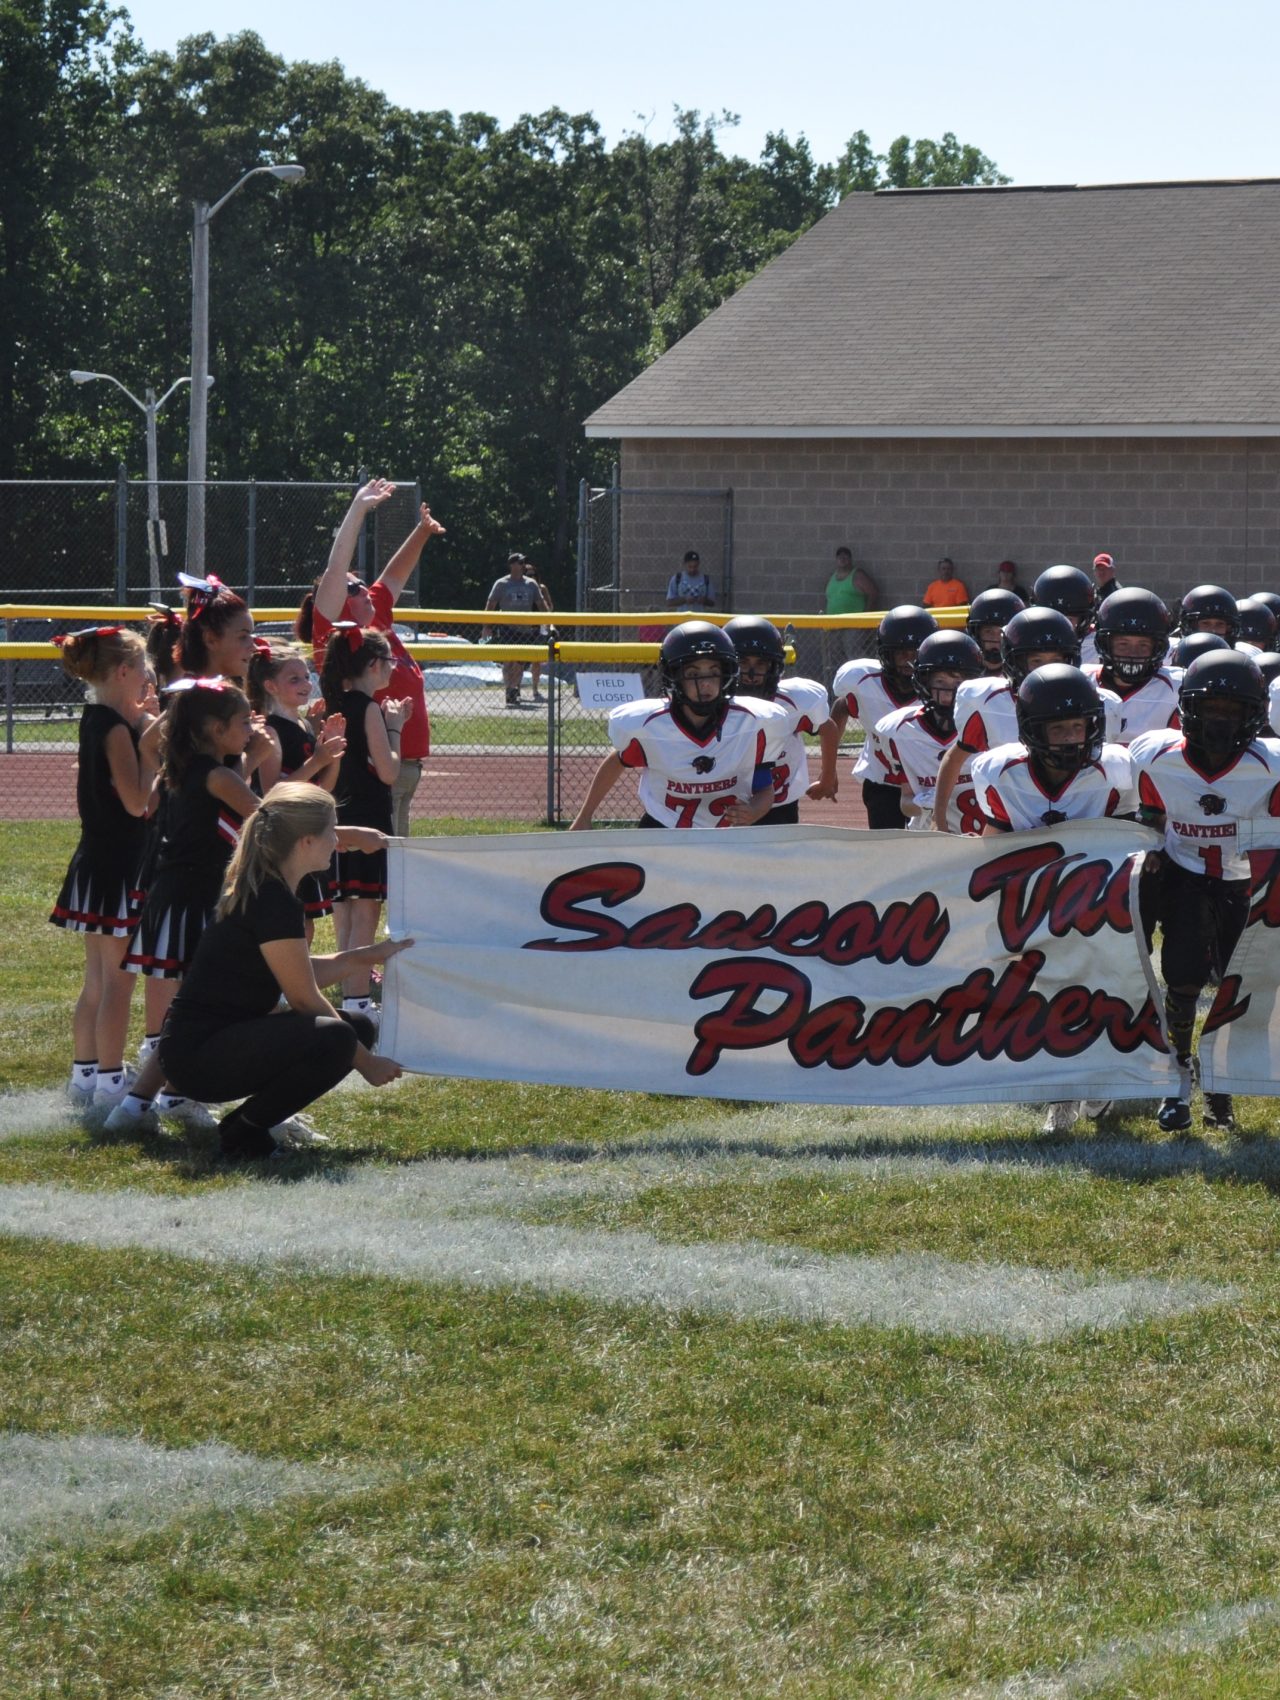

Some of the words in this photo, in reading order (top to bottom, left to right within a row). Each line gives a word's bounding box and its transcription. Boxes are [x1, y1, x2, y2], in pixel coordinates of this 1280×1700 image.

[595, 678, 626, 688] FIELD
[592, 693, 634, 703] CLOSED
[666, 775, 739, 796] PANTHERS
[1198, 844, 1223, 880] 1
[520, 860, 951, 967] Saucon
[685, 948, 1252, 1077] Panthers
